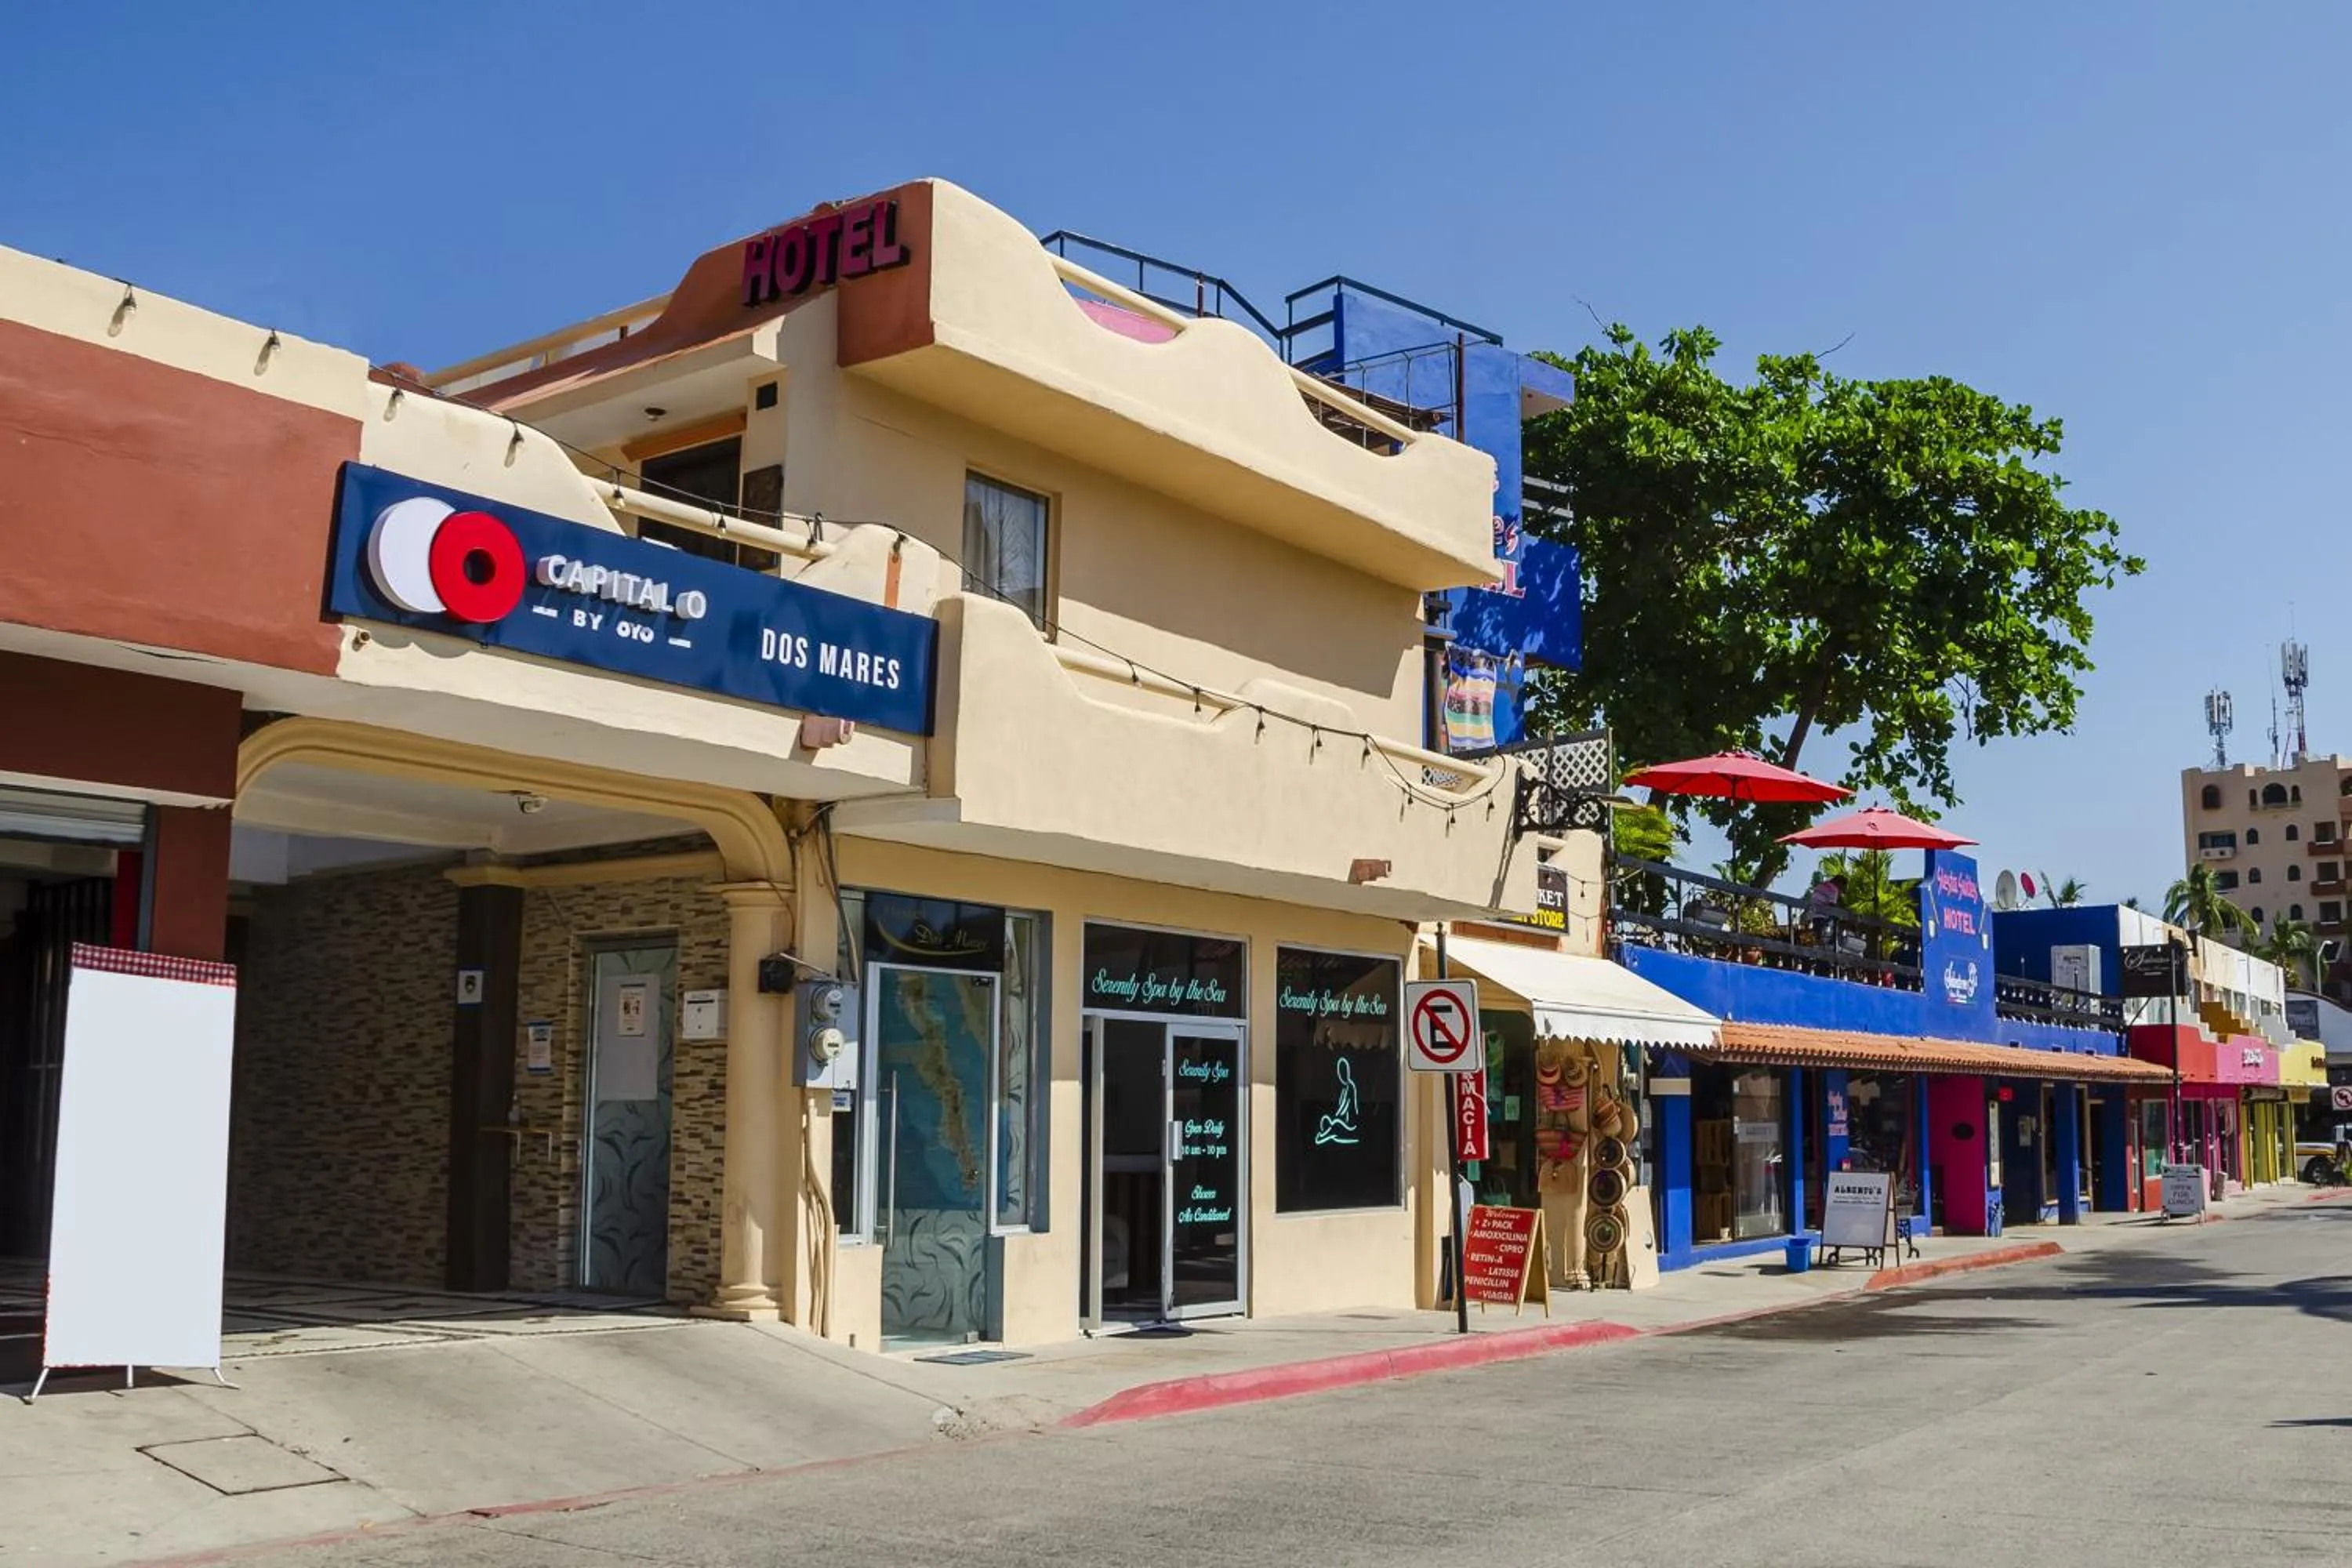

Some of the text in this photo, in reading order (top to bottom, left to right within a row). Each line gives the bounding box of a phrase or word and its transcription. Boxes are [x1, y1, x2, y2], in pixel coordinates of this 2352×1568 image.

[741, 199, 903, 304] HOTEL
[541, 554, 707, 619] CAPITAL O
[573, 608, 654, 643] BY OYO
[761, 628, 900, 689] DOS MARES
[1537, 888, 1564, 906] KET
[1944, 906, 1976, 935] HOTEL
[1142, 973, 1167, 1004] Spa
[1169, 978, 1185, 1005] by
[1186, 978, 1204, 1000] the
[1203, 978, 1227, 1003] Sea
[1319, 989, 1340, 1017] Spa
[1340, 993, 1354, 1018] by
[1354, 994, 1370, 1014] the
[1369, 993, 1387, 1015] Sea
[1211, 1060, 1230, 1083] Spa
[1461, 1071, 1477, 1156] RMACIA
[1185, 1120, 1203, 1138] Open
[1216, 1145, 1227, 1159] pm
[1499, 1243, 1524, 1254] CIPRO
[1482, 1290, 1515, 1301] VIAGRA
